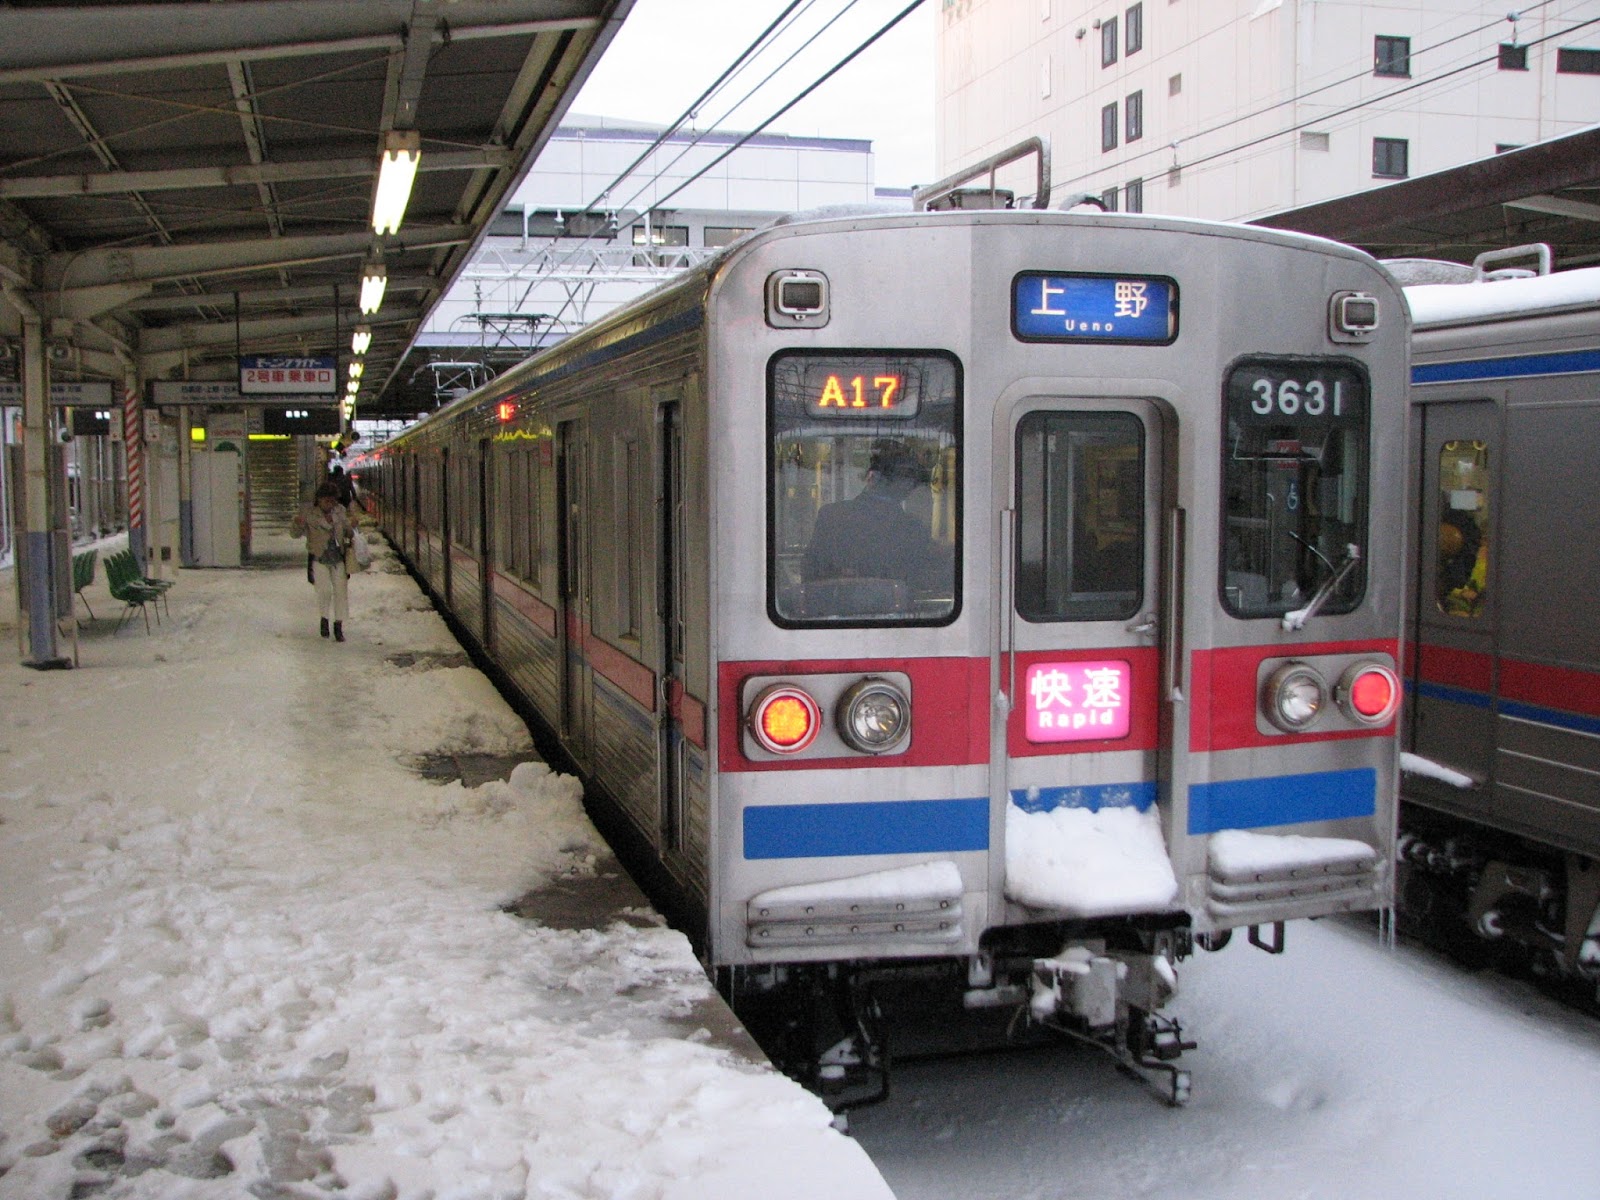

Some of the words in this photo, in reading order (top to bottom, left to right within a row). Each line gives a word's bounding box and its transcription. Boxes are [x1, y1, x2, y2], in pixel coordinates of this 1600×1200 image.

[1031, 279, 1147, 318] 上野
[1065, 319, 1114, 332] Ueno
[818, 373, 900, 408] A17
[1251, 379, 1342, 416] 3631
[1030, 667, 1122, 710] 快速
[1038, 709, 1114, 729] Rapid
